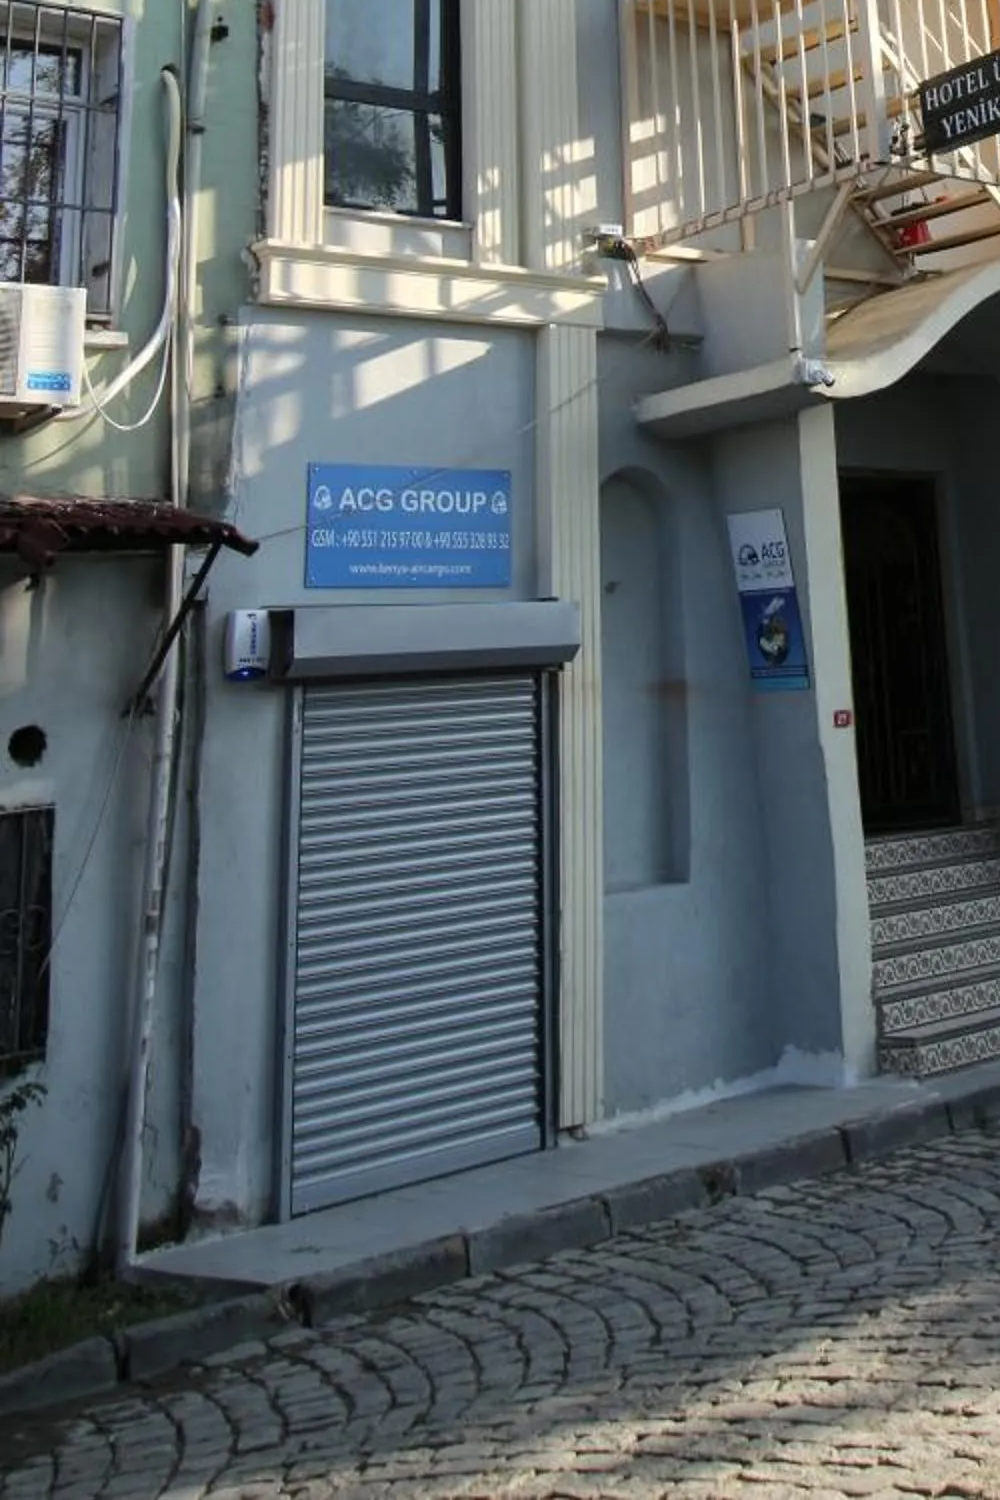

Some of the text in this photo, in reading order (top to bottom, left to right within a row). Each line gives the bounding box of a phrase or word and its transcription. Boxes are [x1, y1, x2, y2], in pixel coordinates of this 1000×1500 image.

[925, 68, 989, 111] HOTEL
[339, 487, 487, 513] ACG GROUP
